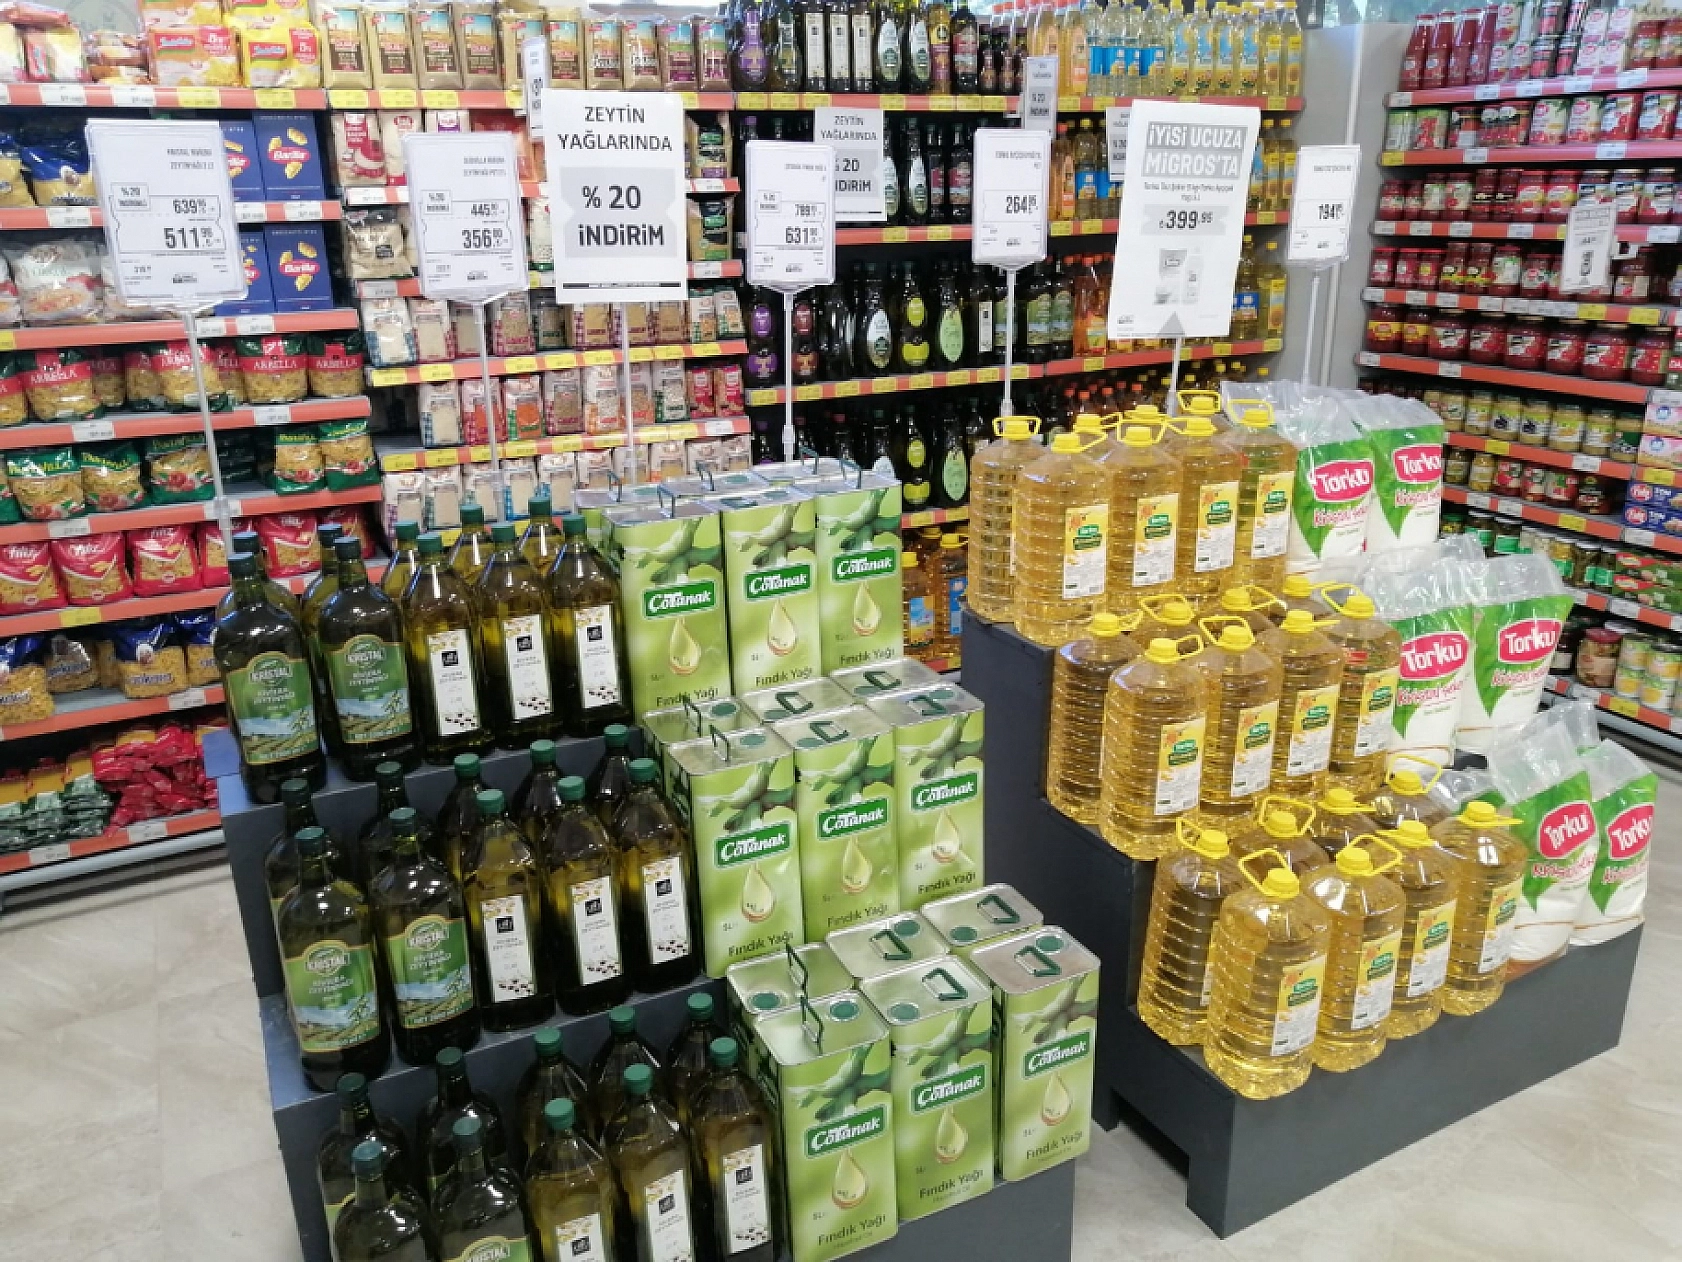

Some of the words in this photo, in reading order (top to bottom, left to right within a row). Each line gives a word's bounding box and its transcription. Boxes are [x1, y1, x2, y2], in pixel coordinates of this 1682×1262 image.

[584, 103, 645, 123] ZEYTİN
[557, 130, 673, 152] YAĞLARINDA
[1190, 127, 1242, 148] UCUZA
[608, 185, 642, 209] 20
[462, 229, 493, 249] 356
[1315, 467, 1370, 494] Torku
[1505, 627, 1557, 656] Torku
[1402, 641, 1463, 673] Torku
[1544, 813, 1590, 851] Torku
